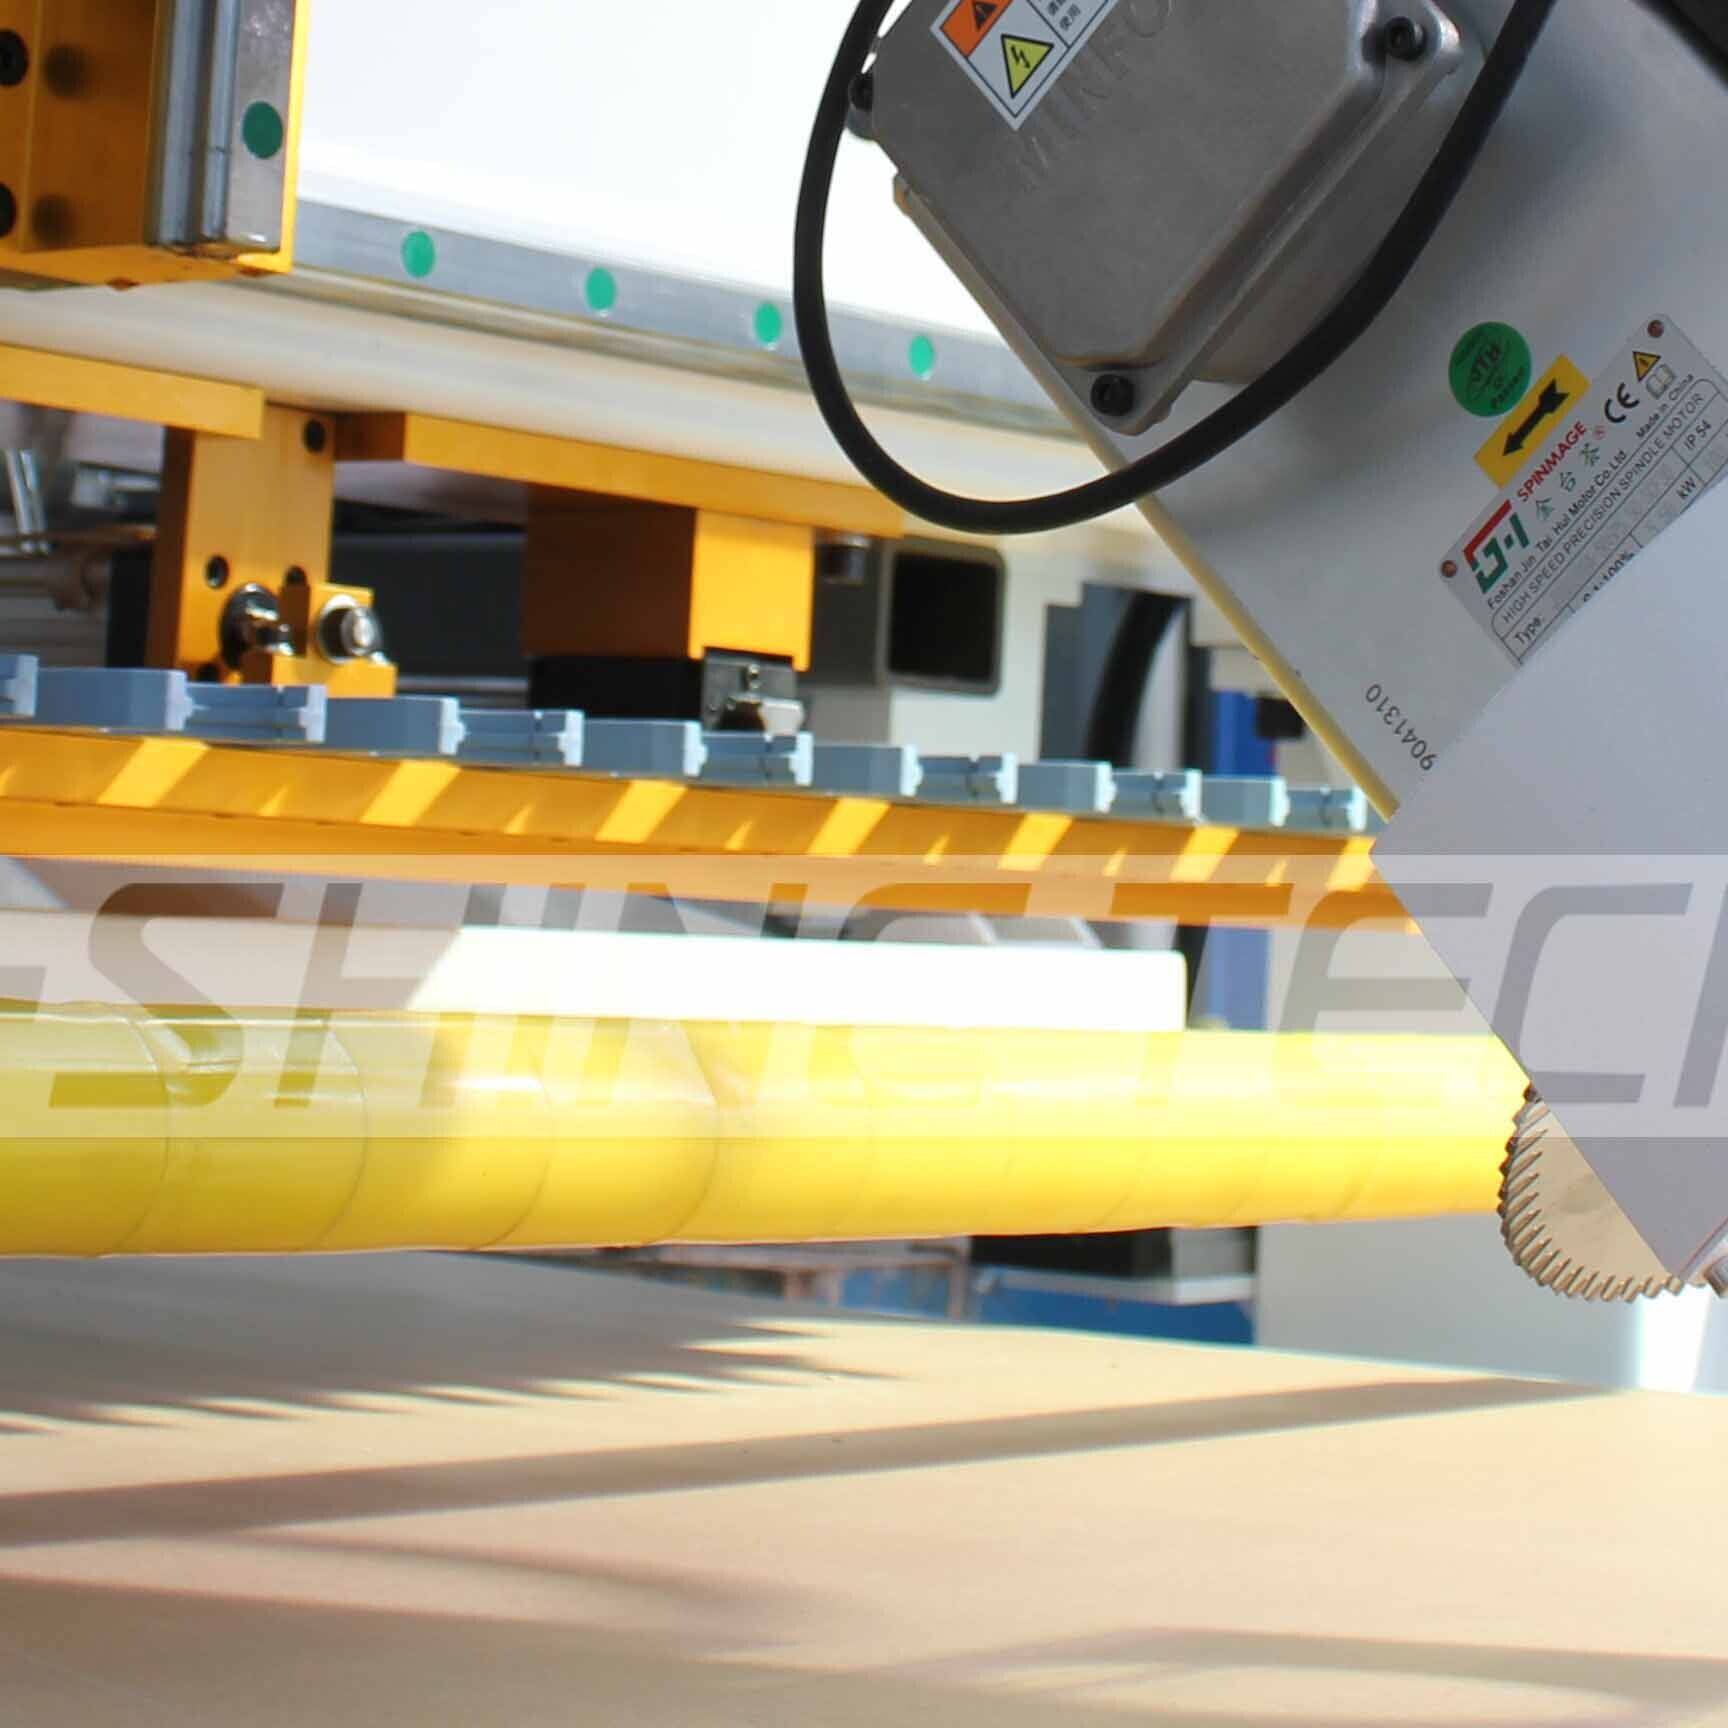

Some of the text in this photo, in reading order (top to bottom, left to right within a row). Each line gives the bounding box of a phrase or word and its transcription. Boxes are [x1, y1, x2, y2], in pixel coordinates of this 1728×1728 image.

[1636, 414, 1660, 438] Made
[1669, 374, 1695, 401] China
[1517, 421, 1587, 502] SPINMAGE
[1676, 477, 1697, 500] kW
[1487, 571, 1523, 610] Foshan
[1521, 555, 1536, 574] Jin
[1568, 484, 1598, 517] Motor
[1502, 393, 1704, 623] HIGH SPEED PRECISION SPINDLE MOTOR
[1365, 683, 1438, 771] 9041310
